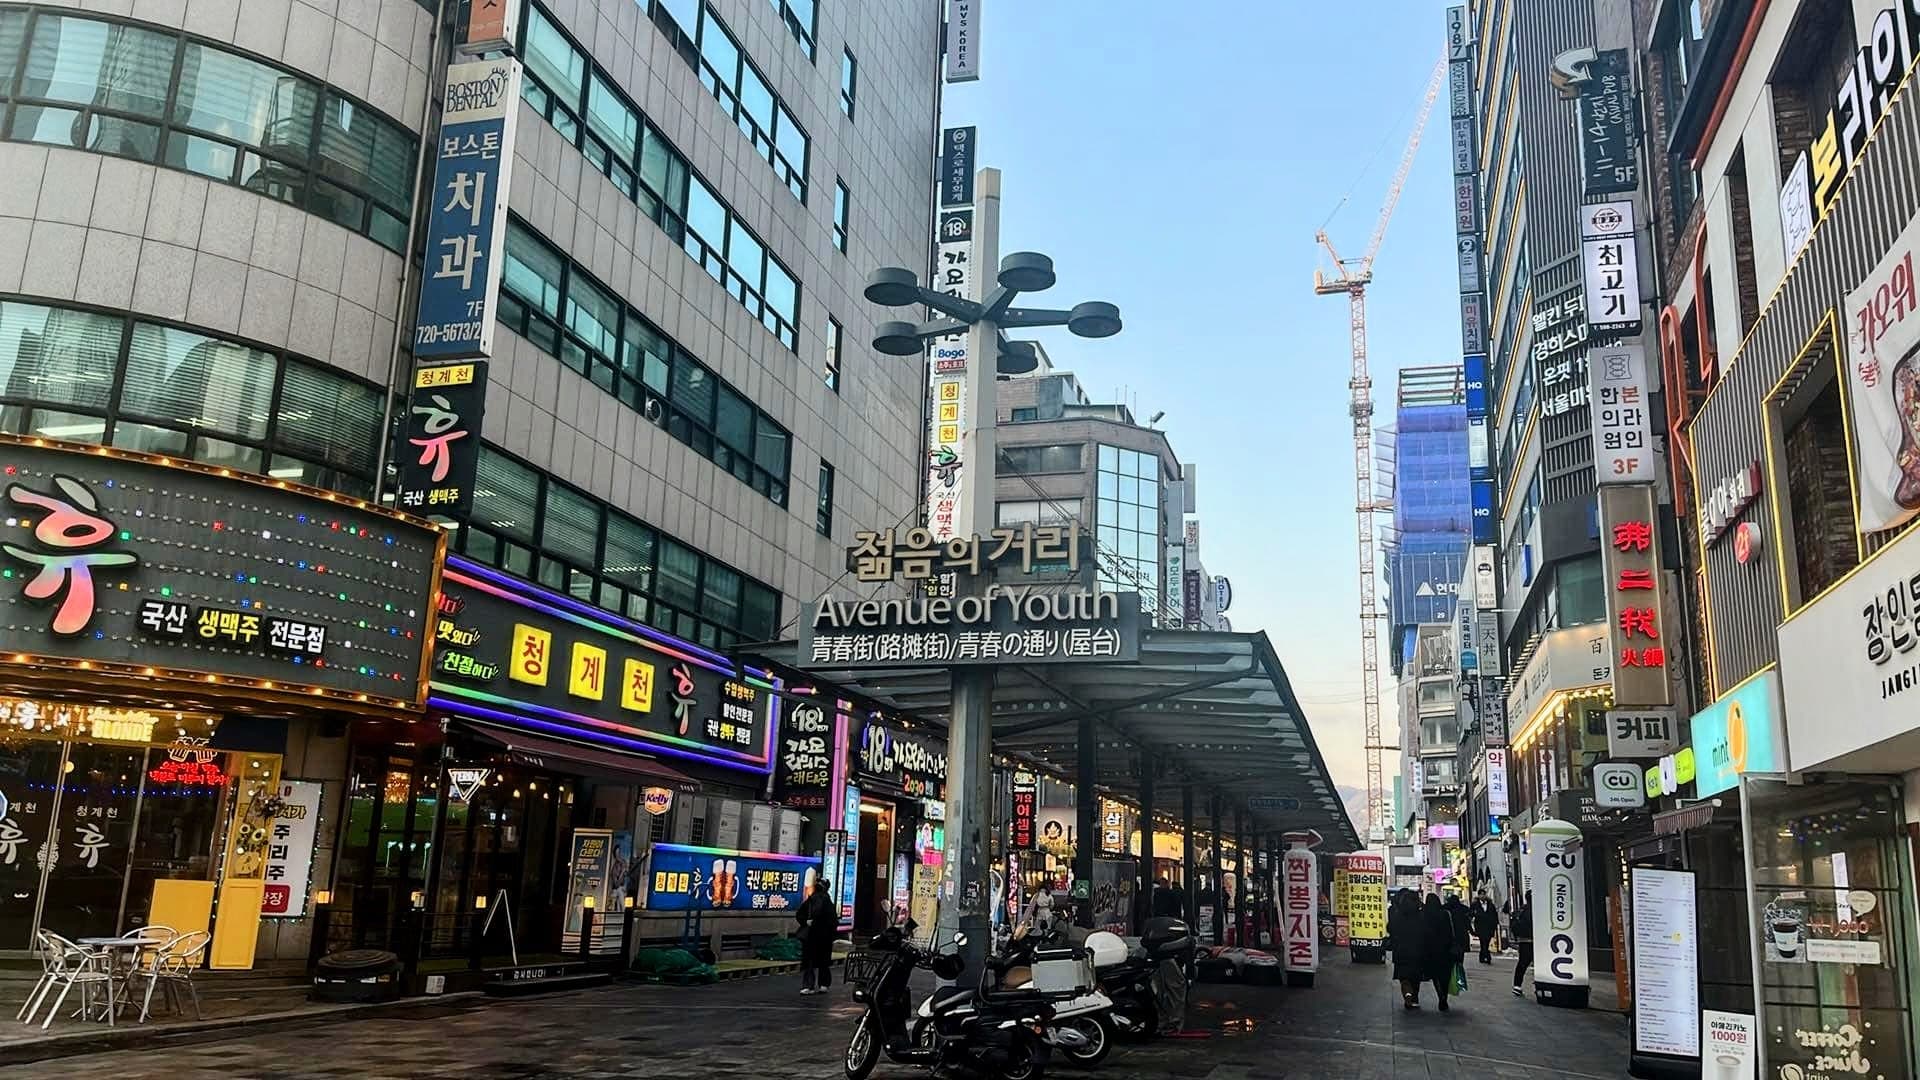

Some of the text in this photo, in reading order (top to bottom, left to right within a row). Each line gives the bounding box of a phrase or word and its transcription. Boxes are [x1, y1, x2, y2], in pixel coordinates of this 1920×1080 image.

[957, 29, 967, 69] KOREA
[1451, 9, 1462, 57] 1987
[447, 76, 501, 100] BOSTON
[1601, 75, 1618, 95] PUB
[446, 91, 498, 114] DENTAL
[439, 132, 500, 160] 보스톤
[1614, 166, 1635, 183] 5F
[432, 172, 487, 291] 치과
[947, 222, 962, 237] 18
[1598, 244, 1626, 316] 최고기
[466, 300, 484, 318] 7F
[421, 368, 469, 386] 청계천
[940, 383, 957, 441] 청계천
[1540, 383, 1592, 419] 서울미
[1620, 384, 1644, 449] 본라인
[1600, 387, 1622, 450] 한의원
[408, 394, 469, 483] 휴
[931, 445, 963, 488] 휴
[1613, 457, 1639, 475] 3F
[403, 487, 459, 507] 국산 생맥주
[936, 500, 954, 538] 생맥주
[2, 474, 139, 635] 휴
[852, 519, 1079, 582] 젊음의 거리
[811, 583, 1119, 629] Avenue of Youth
[141, 600, 325, 653] 국산 생맥주 전문점
[522, 635, 650, 705] 청계천
[671, 663, 697, 736] 휴
[1616, 716, 1671, 741] 커피
[1488, 752, 1503, 768] 약
[1711, 736, 1730, 768] mint
[451, 770, 481, 783] TERRA
[1492, 773, 1503, 792] 치과
[1608, 775, 1630, 787] CU
[9, 801, 37, 815] 계천
[76, 804, 119, 819] 청계천
[646, 793, 669, 806] Kelly
[73, 822, 111, 869] 휴
[1545, 852, 1576, 870] CU
[746, 869, 800, 892] 국산 생맥주 전문점
[1288, 857, 1313, 967] 짬뽕지존
[1555, 883, 1567, 923] Nice to
[1550, 932, 1575, 980] CU
[1710, 1029, 1747, 1044] 1000원
